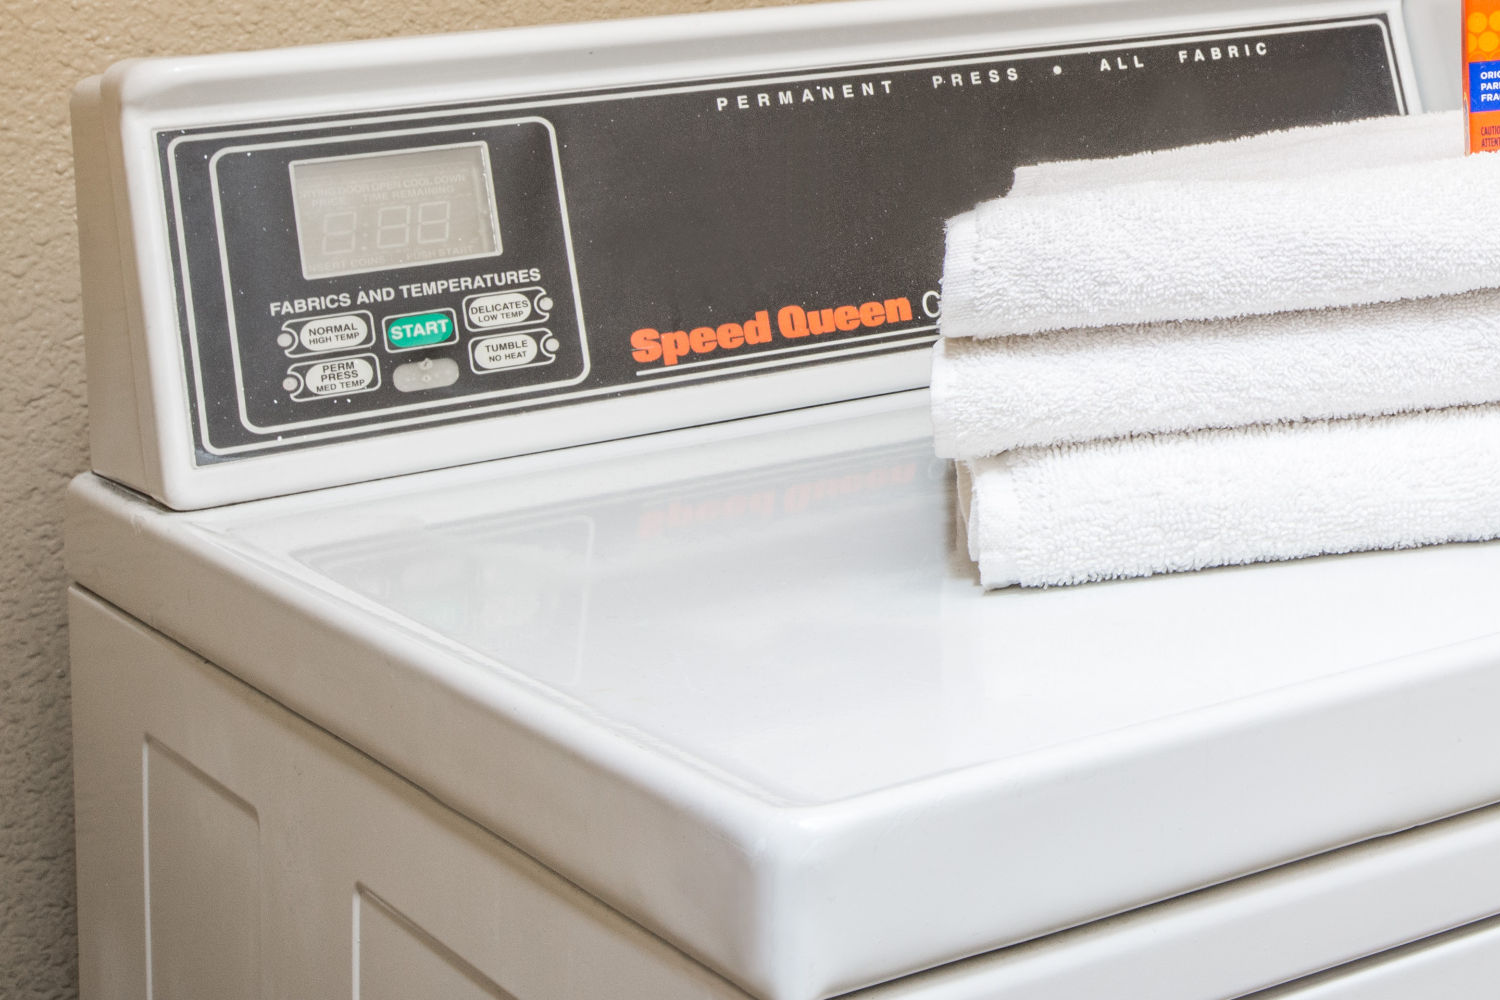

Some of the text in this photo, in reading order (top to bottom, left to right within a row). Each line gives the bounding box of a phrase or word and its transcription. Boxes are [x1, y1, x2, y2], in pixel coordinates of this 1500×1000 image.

[716, 42, 1267, 112] PERMANENT PRESS ALL FABRIC
[269, 268, 541, 317] FABRICS AND TEMPERATURES
[471, 300, 529, 315] DELICATES
[477, 310, 524, 323] LOW TEMP
[308, 322, 358, 336] NORMAL
[390, 319, 449, 341] START
[630, 310, 772, 366] Speed
[777, 297, 913, 339] Queen
[308, 332, 360, 346] HIGH TEMP
[485, 339, 528, 353] TUMBLE
[488, 350, 527, 363] NO HEAT
[322, 361, 355, 374] PERM
[320, 369, 359, 383] PRESS
[316, 379, 366, 393] MED TEMP
